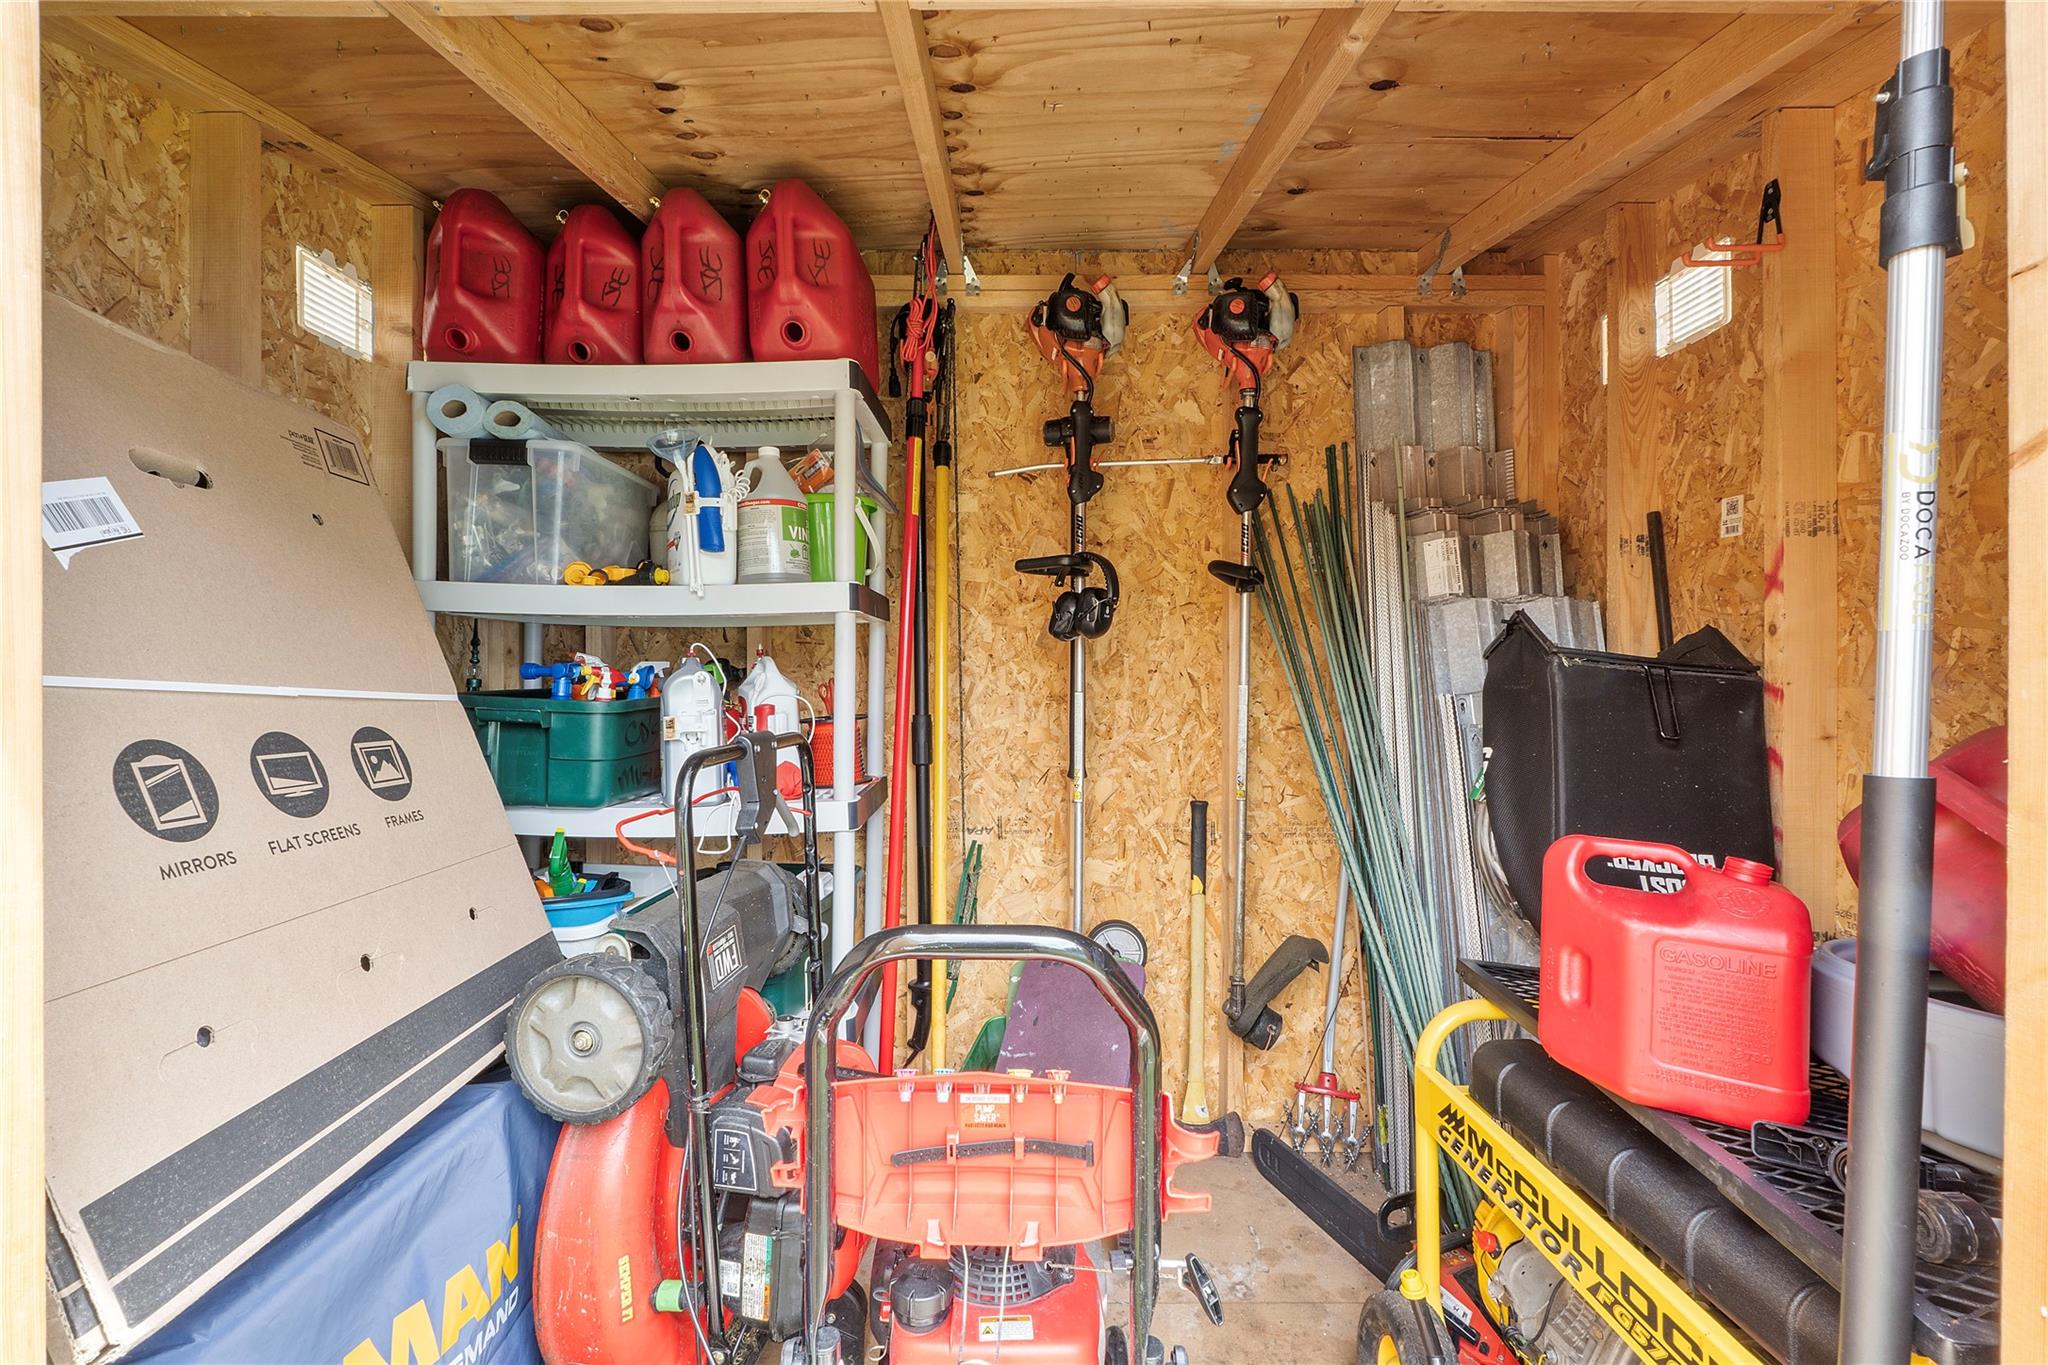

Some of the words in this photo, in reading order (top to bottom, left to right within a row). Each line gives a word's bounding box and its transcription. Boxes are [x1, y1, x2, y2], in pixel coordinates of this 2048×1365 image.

[492, 255, 512, 298] JOE
[602, 266, 631, 307] JOE
[699, 245, 722, 301] JOE
[1901, 491, 1911, 504] BY
[1899, 508, 1911, 561] DOCAZOO
[267, 835, 302, 855] FLAT
[304, 822, 362, 848] SCREENS
[384, 809, 425, 829] FRAMES
[967, 826, 994, 835] APA
[159, 850, 238, 881] MIRRORS
[714, 942, 740, 981] FWD
[1659, 946, 1777, 979] GASOLINE
[1438, 1124, 1582, 1282] GENERATOR
[1467, 1123, 1719, 1365] McCULLOC
[618, 1254, 633, 1309] SEMPER
[1594, 1285, 1682, 1365] FG57
